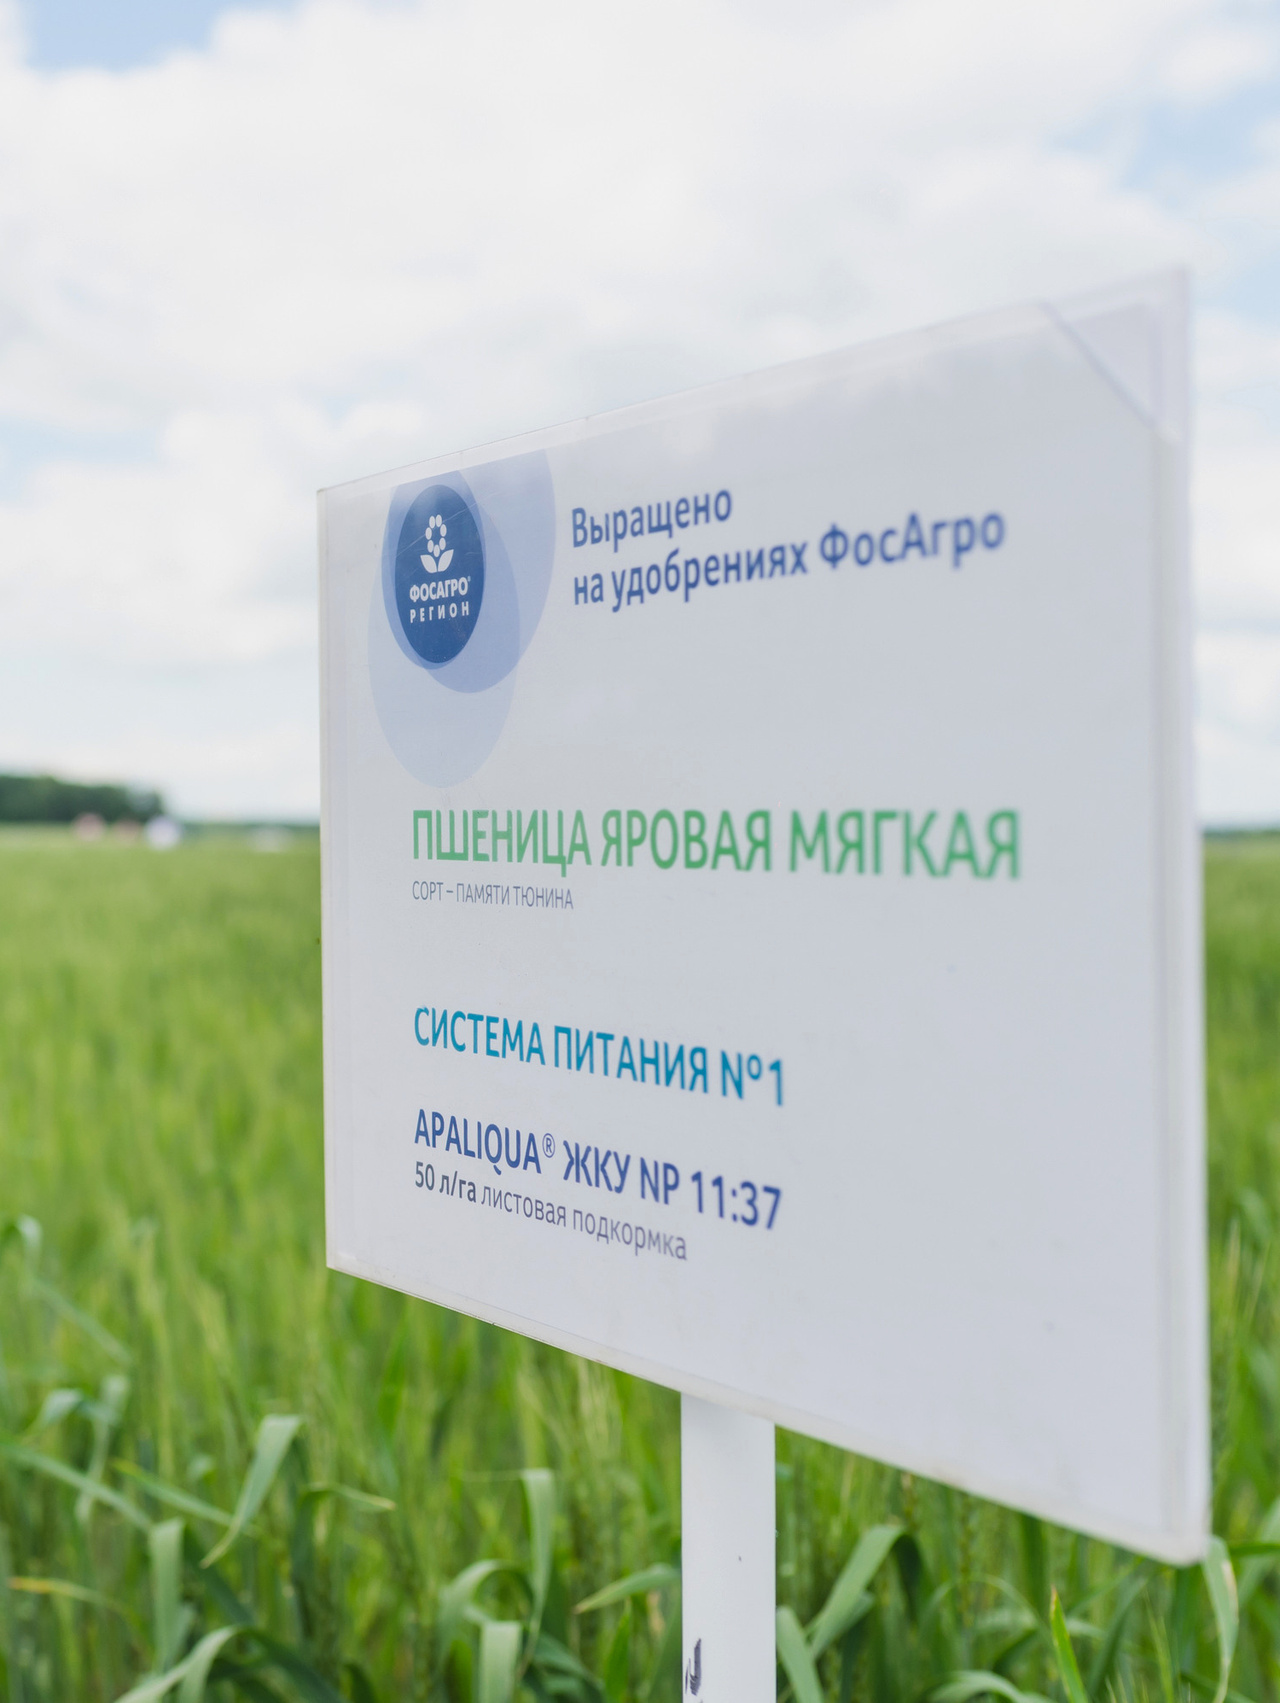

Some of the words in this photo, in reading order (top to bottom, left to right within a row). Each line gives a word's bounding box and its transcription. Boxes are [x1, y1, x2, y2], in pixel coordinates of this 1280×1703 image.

[571, 489, 732, 553] Выращено
[409, 576, 469, 603] ФОСАГРО
[573, 572, 604, 605] на
[611, 542, 809, 613] удобрениях
[819, 511, 1006, 571] ФосАгро
[409, 601, 469, 624] РЕГИОН
[412, 809, 592, 878] ПШЕНИЦА
[600, 809, 772, 872] ЯРОВАЯ
[788, 809, 1021, 881] МЯГКАЯ
[412, 880, 444, 901] СОРТ
[456, 883, 510, 906] ПАМЯТИ
[513, 885, 574, 910] ТЮНИНА
[414, 1007, 546, 1066] СИСТЕМА
[553, 1025, 709, 1094] ПИТАНИЯ
[415, 1160, 435, 1191] 50
[439, 1170, 477, 1204] л/га
[480, 1185, 567, 1228] листовая
[572, 1208, 687, 1261] подкормка
[562, 1139, 631, 1194] ЖКУ
[639, 1156, 680, 1205] NP
[690, 1170, 782, 1230] 11:37
